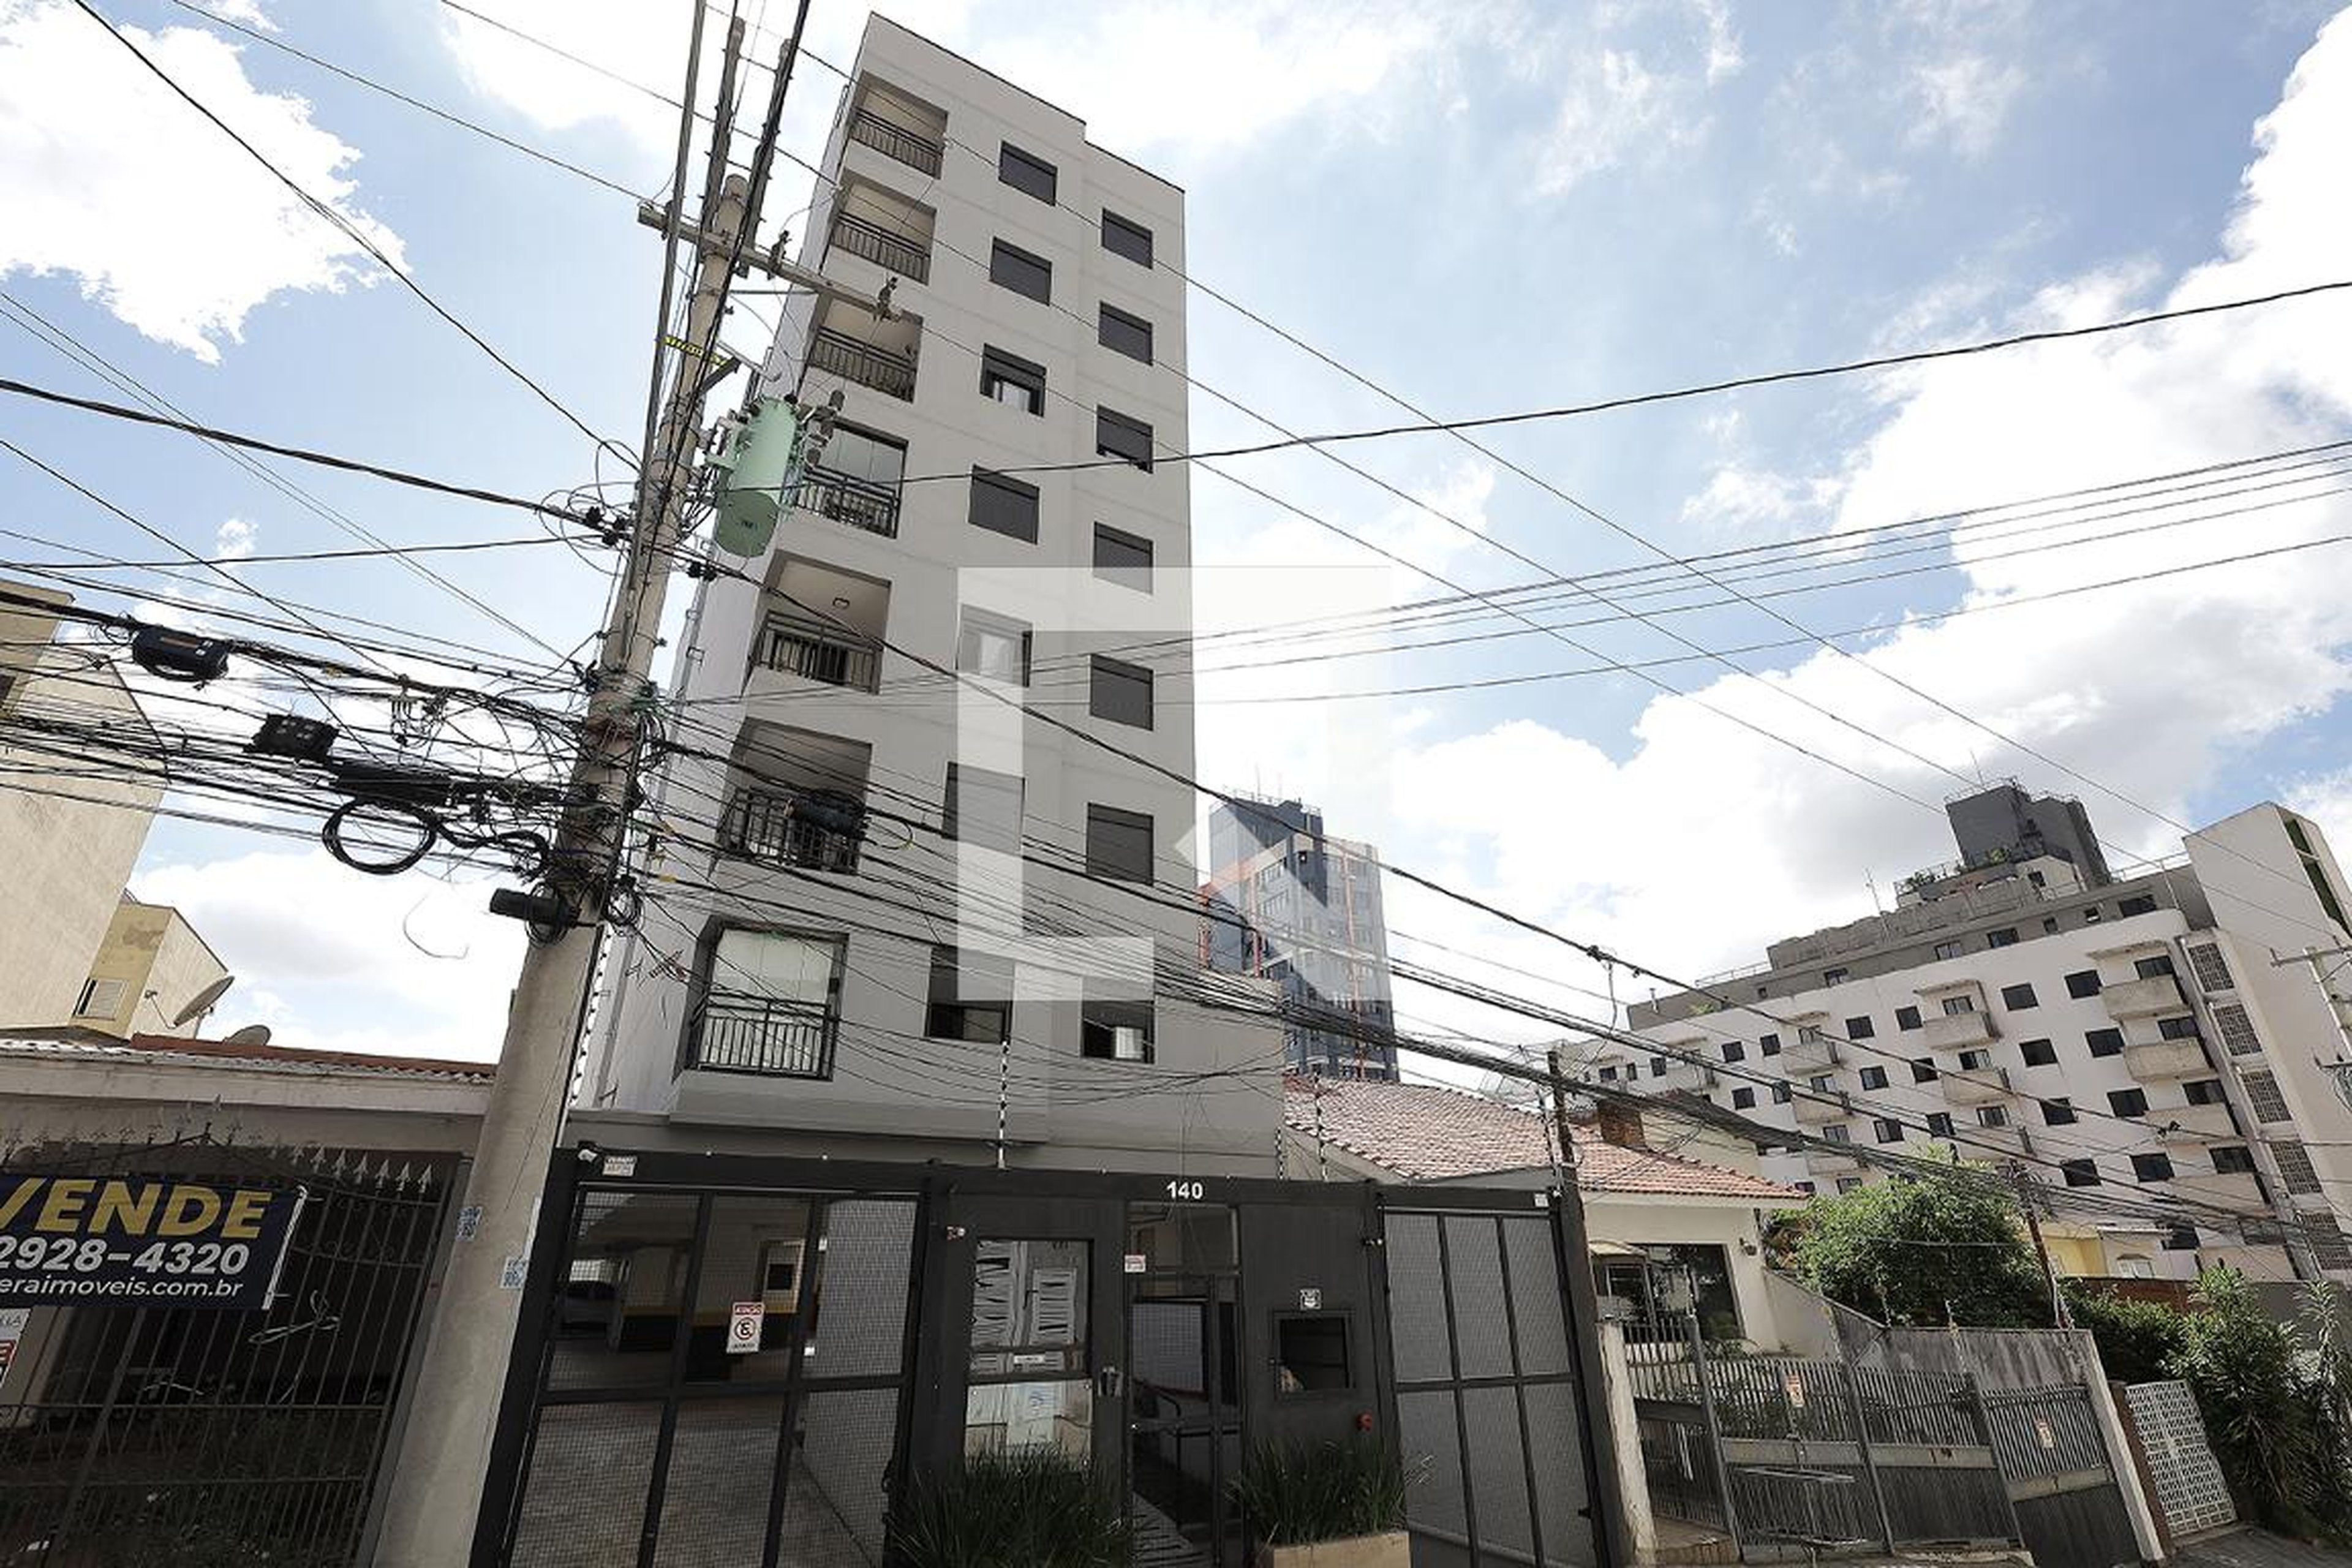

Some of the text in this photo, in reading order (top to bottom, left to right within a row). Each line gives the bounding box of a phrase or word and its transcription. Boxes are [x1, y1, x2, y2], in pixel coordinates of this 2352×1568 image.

[1166, 1181, 1203, 1199] 140
[0, 1235, 249, 1275] 2928-4320
[0, 1274, 244, 1295] eraimoveis.com.br
